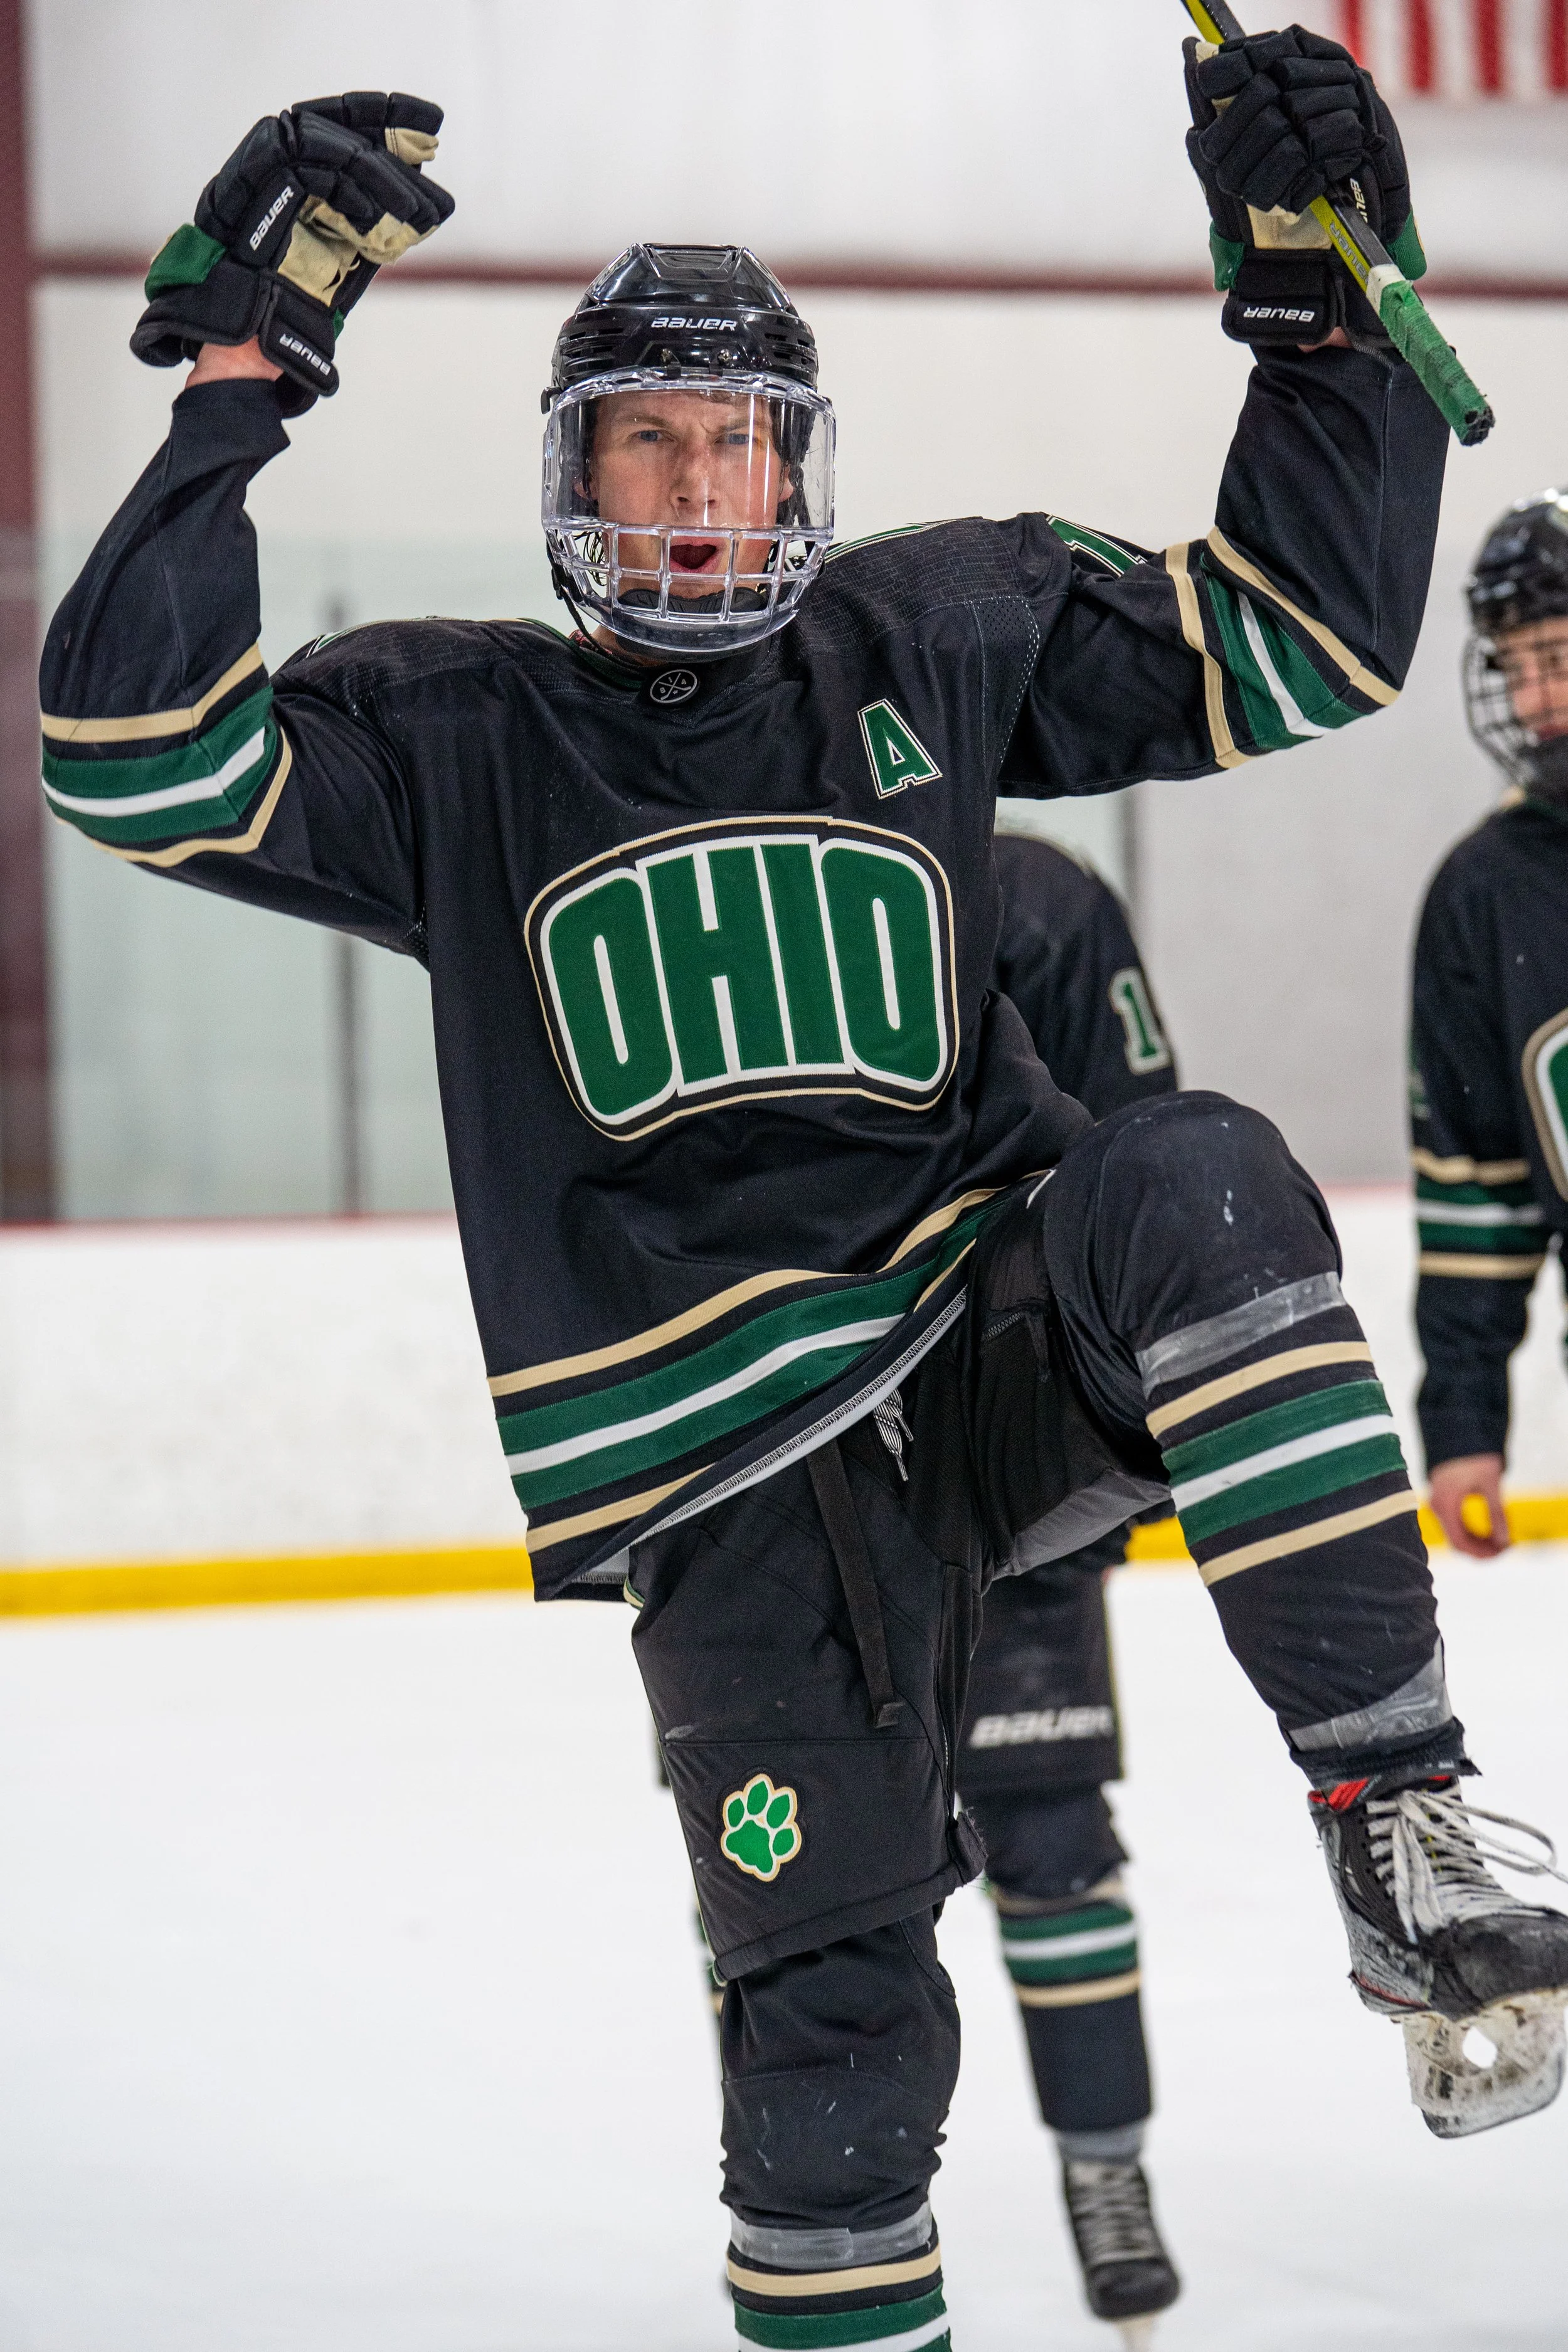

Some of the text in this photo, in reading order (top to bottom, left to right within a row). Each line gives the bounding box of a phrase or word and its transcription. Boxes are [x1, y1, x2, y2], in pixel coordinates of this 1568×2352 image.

[249, 186, 294, 251] BAUER
[1350, 177, 1368, 224] BAU
[1330, 221, 1369, 285] AUER
[651, 317, 737, 331] BAUER
[1243, 307, 1315, 322] BAUER
[279, 333, 331, 376] BAUER
[858, 699, 943, 799] A
[540, 834, 948, 1125] OHIO
[1108, 966, 1172, 1074] 1
[969, 1704, 1115, 1749] BAUER
